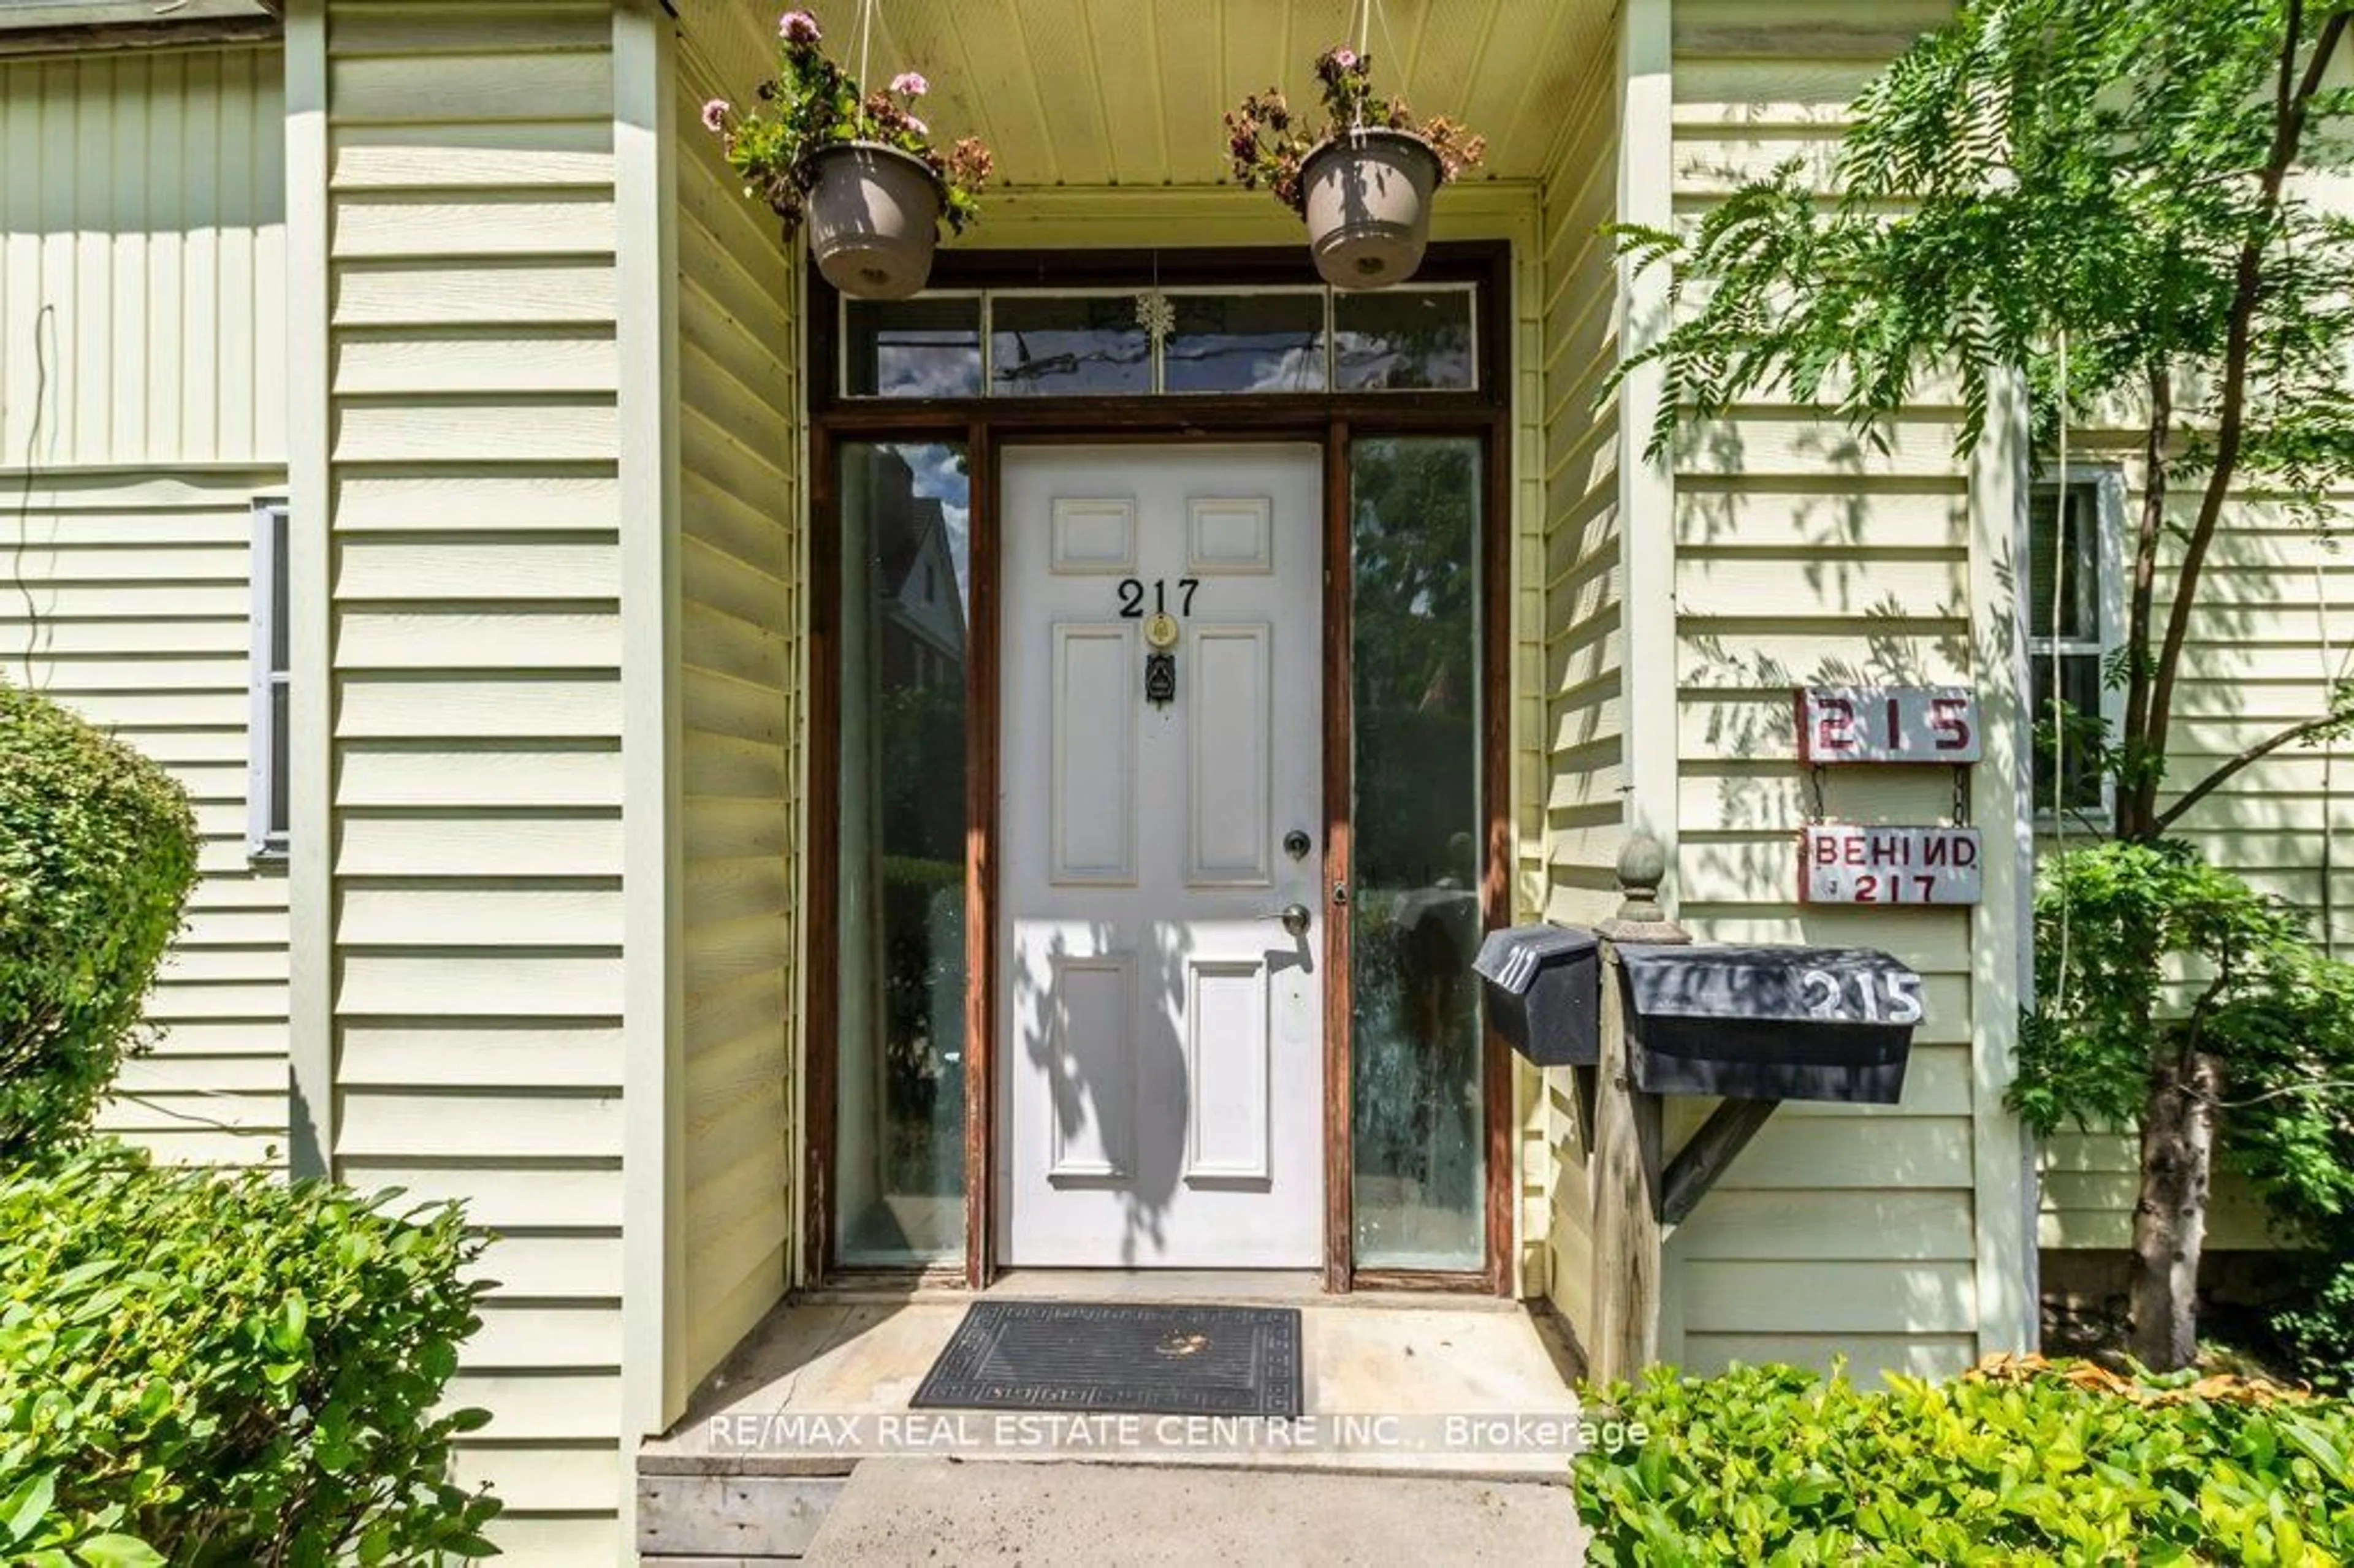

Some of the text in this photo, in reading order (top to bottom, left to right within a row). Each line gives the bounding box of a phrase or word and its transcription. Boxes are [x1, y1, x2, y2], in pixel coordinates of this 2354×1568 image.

[1118, 578, 1200, 618] 217
[1818, 698, 1971, 750] 215
[1816, 836, 1976, 867] BEHIND
[1855, 875, 1935, 902] 217
[1804, 970, 1922, 1022] 215
